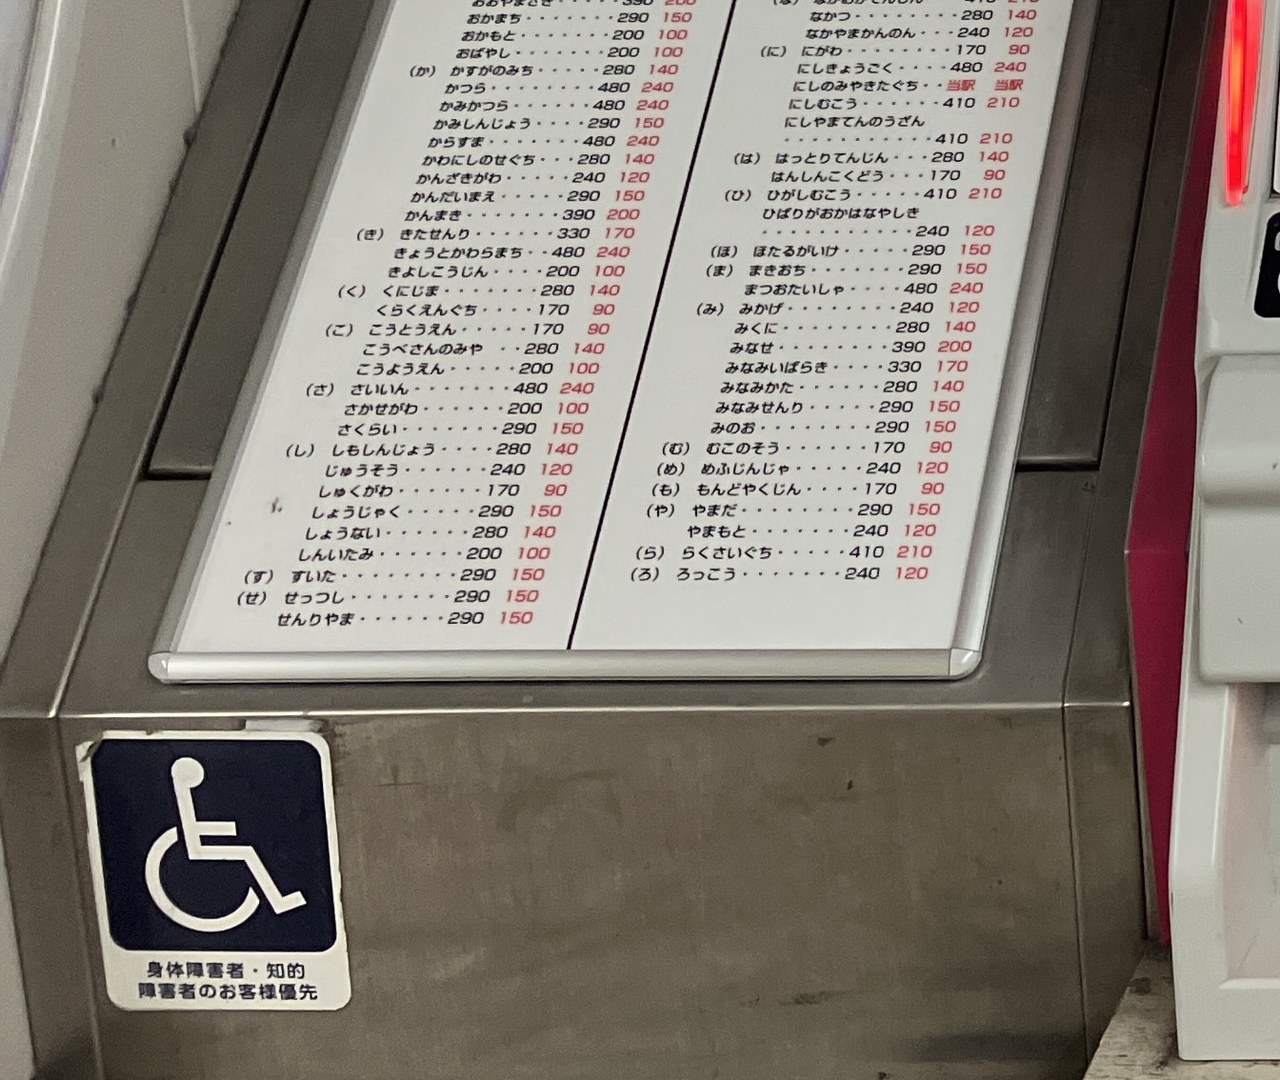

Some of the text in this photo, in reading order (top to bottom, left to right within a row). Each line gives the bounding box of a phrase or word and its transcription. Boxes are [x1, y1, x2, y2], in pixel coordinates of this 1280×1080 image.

[805, 26, 1035, 39] なかやまかんのん 240 120
[393, 245, 631, 260] きょうとかわらまち 480 240
[752, 243, 992, 257] ほたるがいけ 290 150
[676, 566, 930, 583] ろっこう 240 120
[276, 610, 535, 627] せんりやま 290 150
[147, 961, 305, 979] 身体障害者・知的
[137, 982, 319, 1002] 障害者のお客様優先
